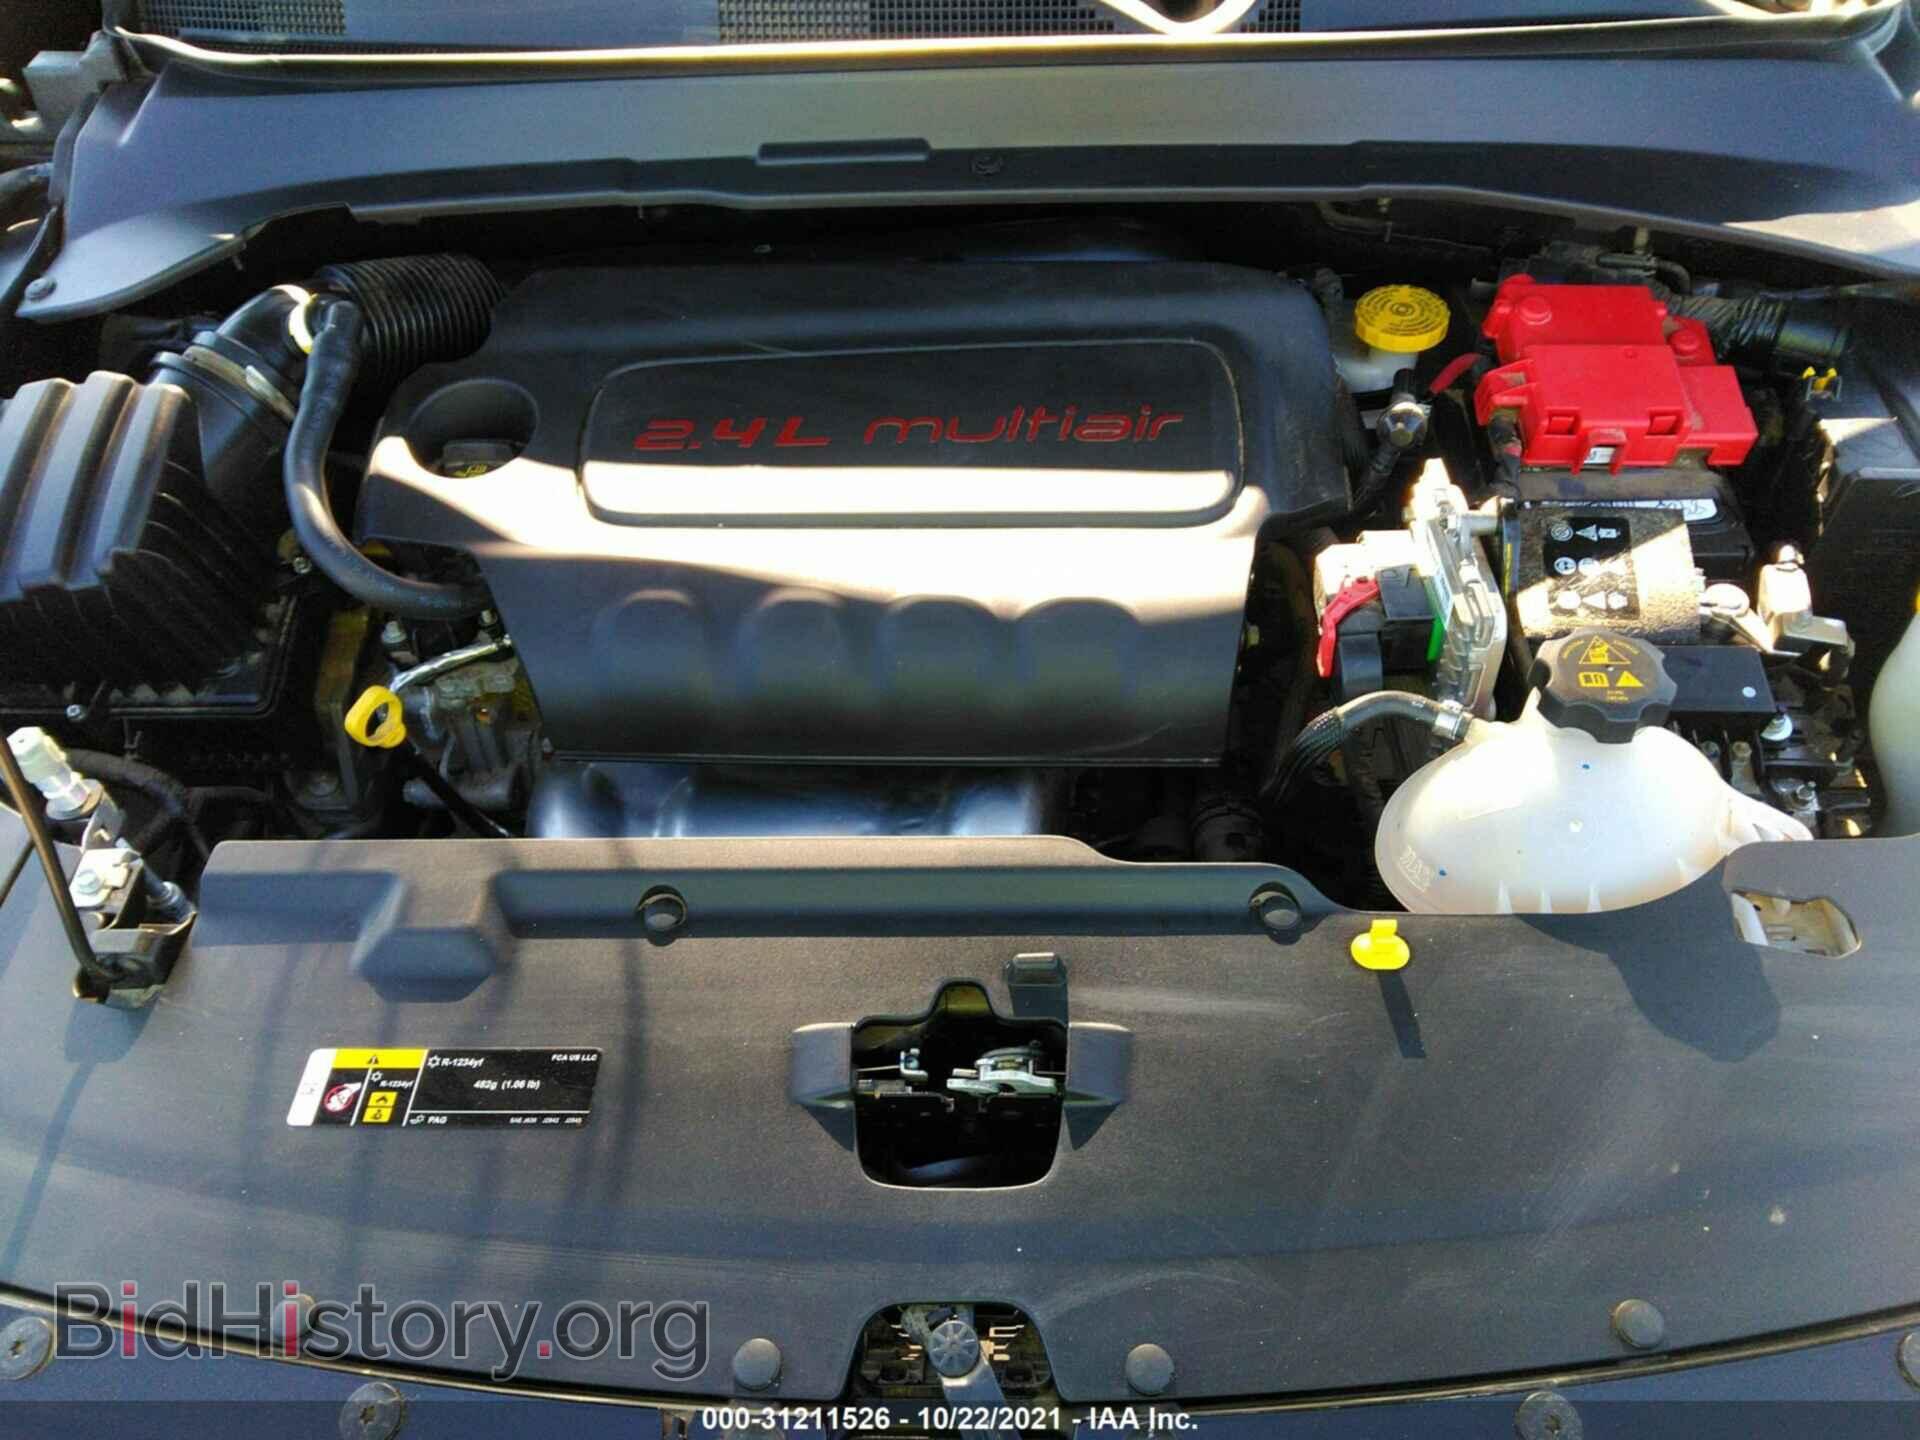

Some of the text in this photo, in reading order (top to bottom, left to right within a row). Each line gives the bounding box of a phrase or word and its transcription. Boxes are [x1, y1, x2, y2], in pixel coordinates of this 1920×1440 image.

[864, 405, 1184, 444] multiair
[440, 1057, 484, 1069] R-1234yf
[551, 1053, 568, 1061] FCA
[581, 1053, 598, 1061] LLC
